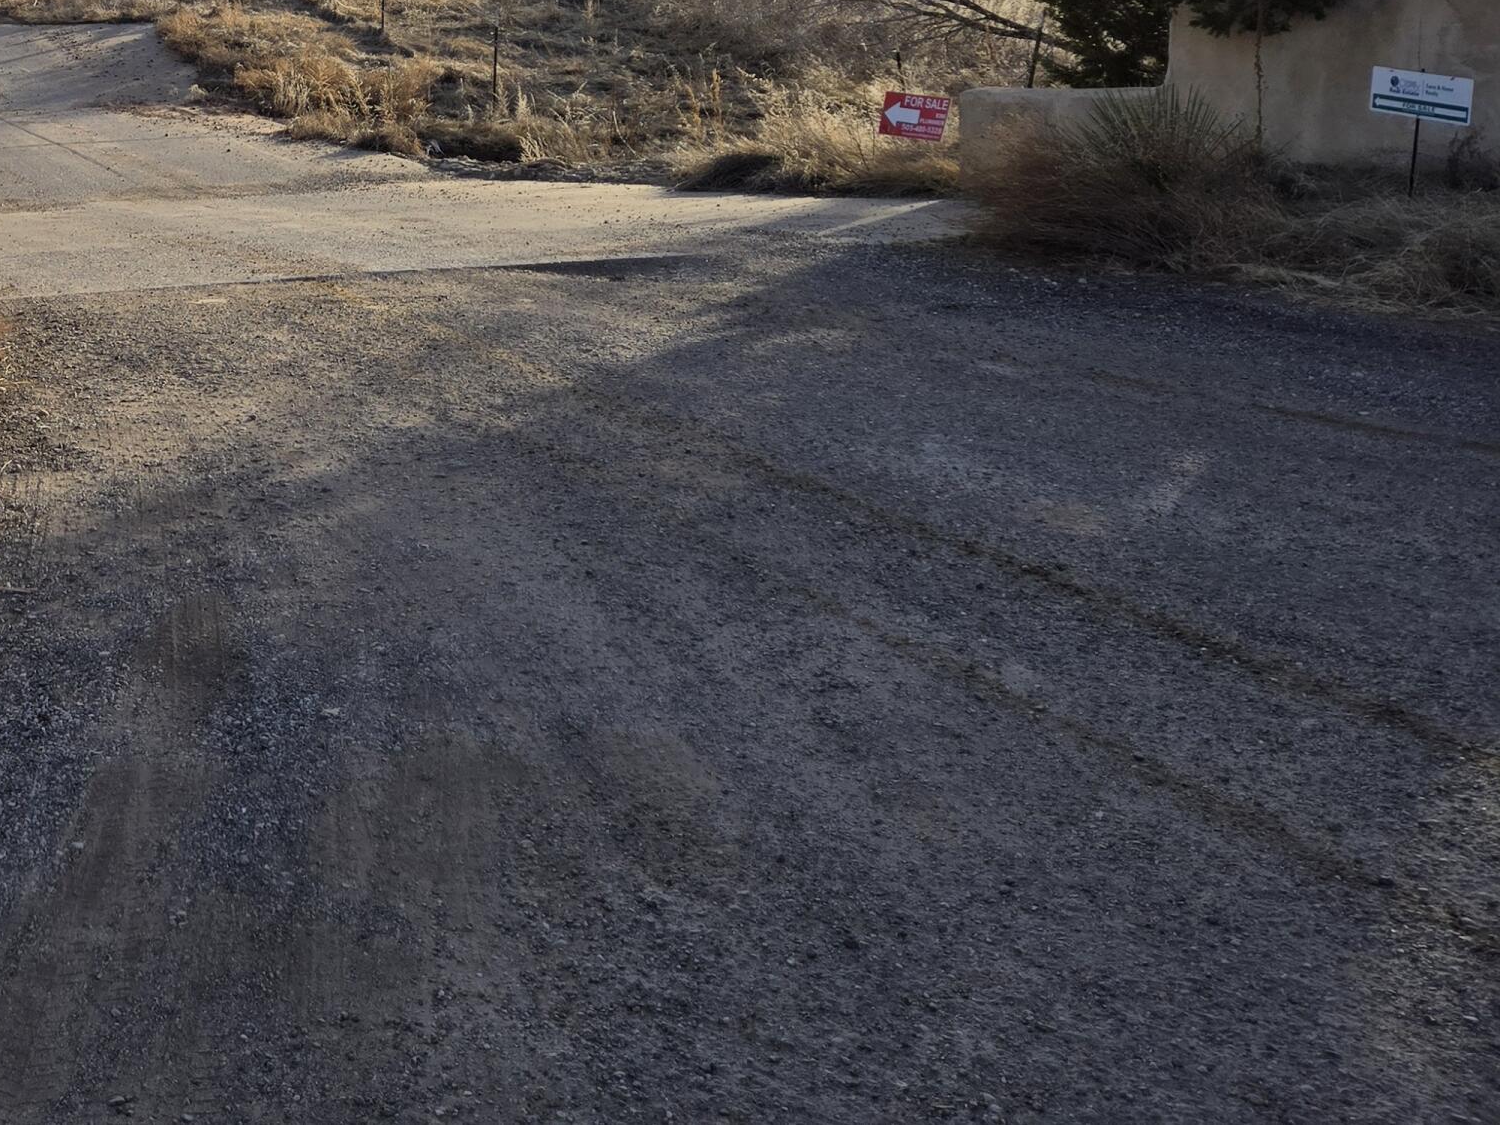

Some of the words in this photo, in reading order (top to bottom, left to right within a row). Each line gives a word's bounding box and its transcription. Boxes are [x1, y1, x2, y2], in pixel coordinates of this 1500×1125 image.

[905, 96, 924, 107] FOR
[925, 99, 949, 110] SALE
[1418, 105, 1435, 113] SALE
